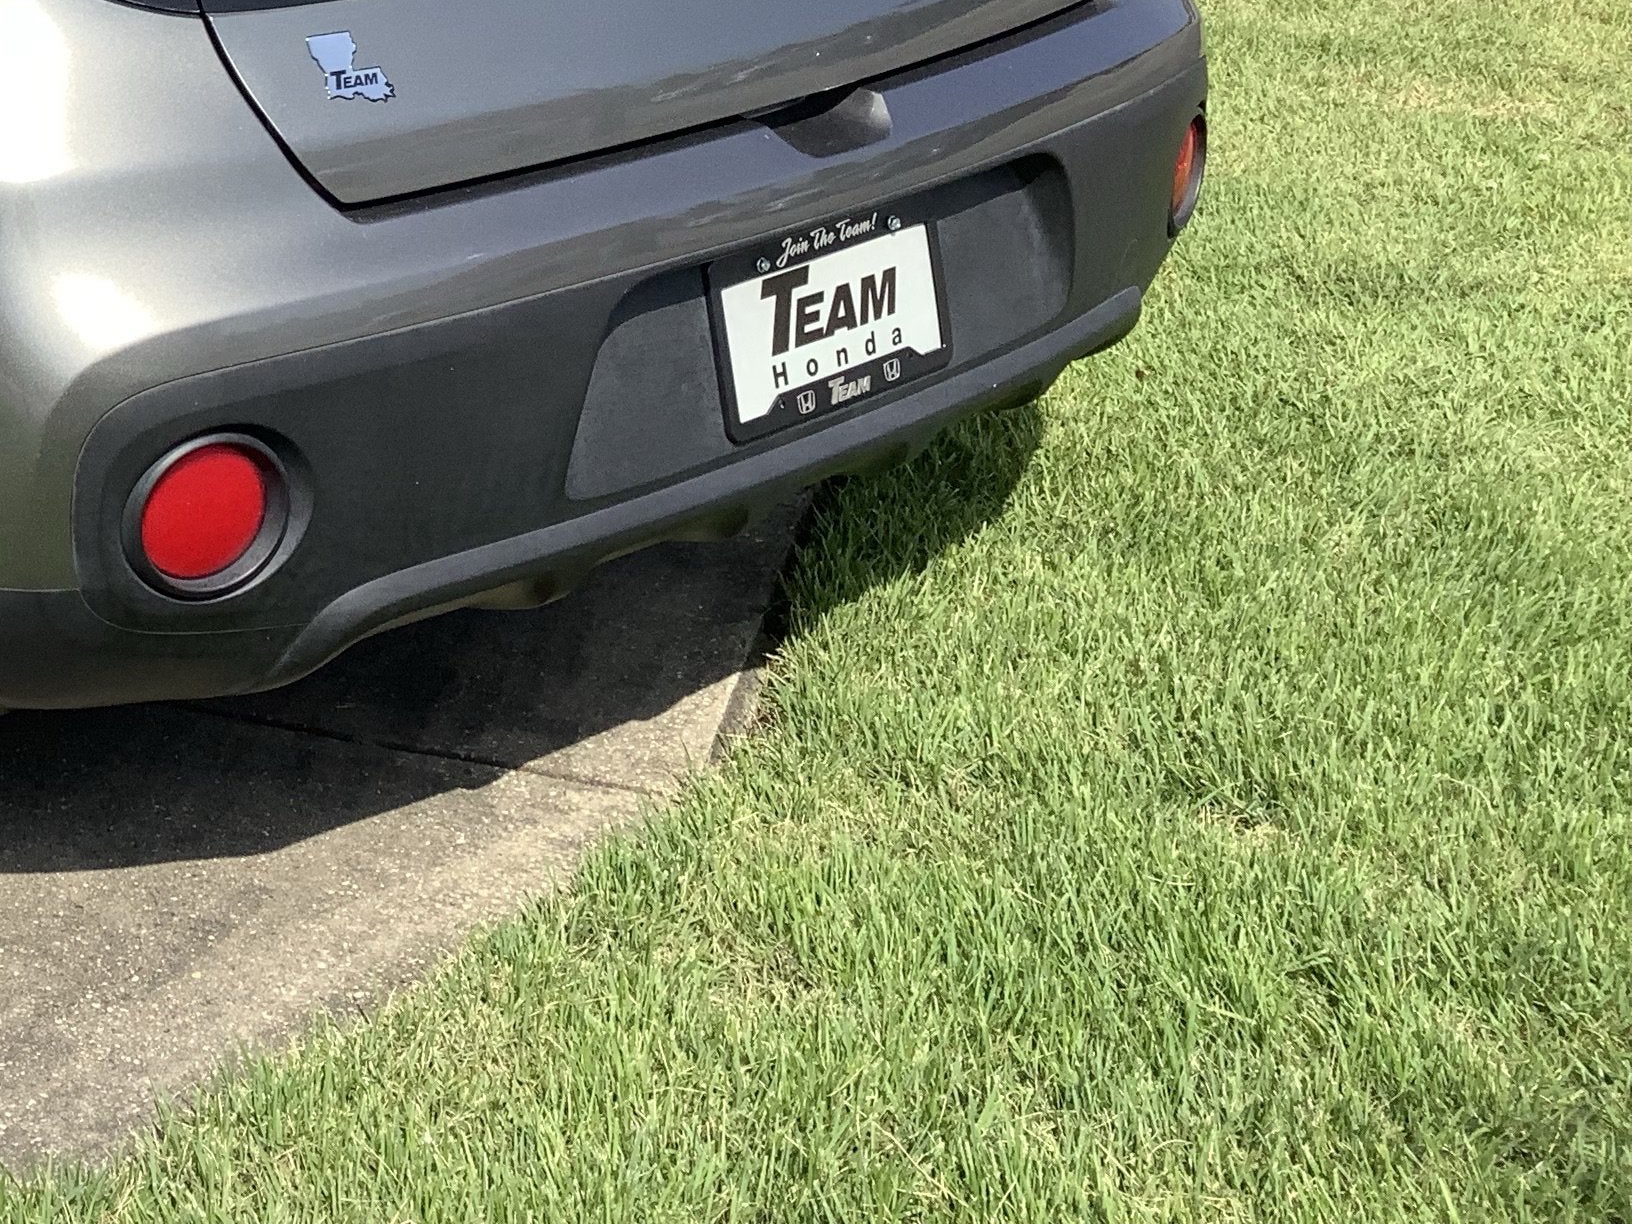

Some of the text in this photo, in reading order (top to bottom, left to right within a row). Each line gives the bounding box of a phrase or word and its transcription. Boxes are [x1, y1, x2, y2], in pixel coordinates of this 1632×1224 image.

[330, 70, 379, 90] TEAM
[776, 211, 878, 267] Join The Team!
[759, 265, 897, 357] TEAM
[772, 327, 903, 388] Honda
[828, 375, 872, 405] TEAM
